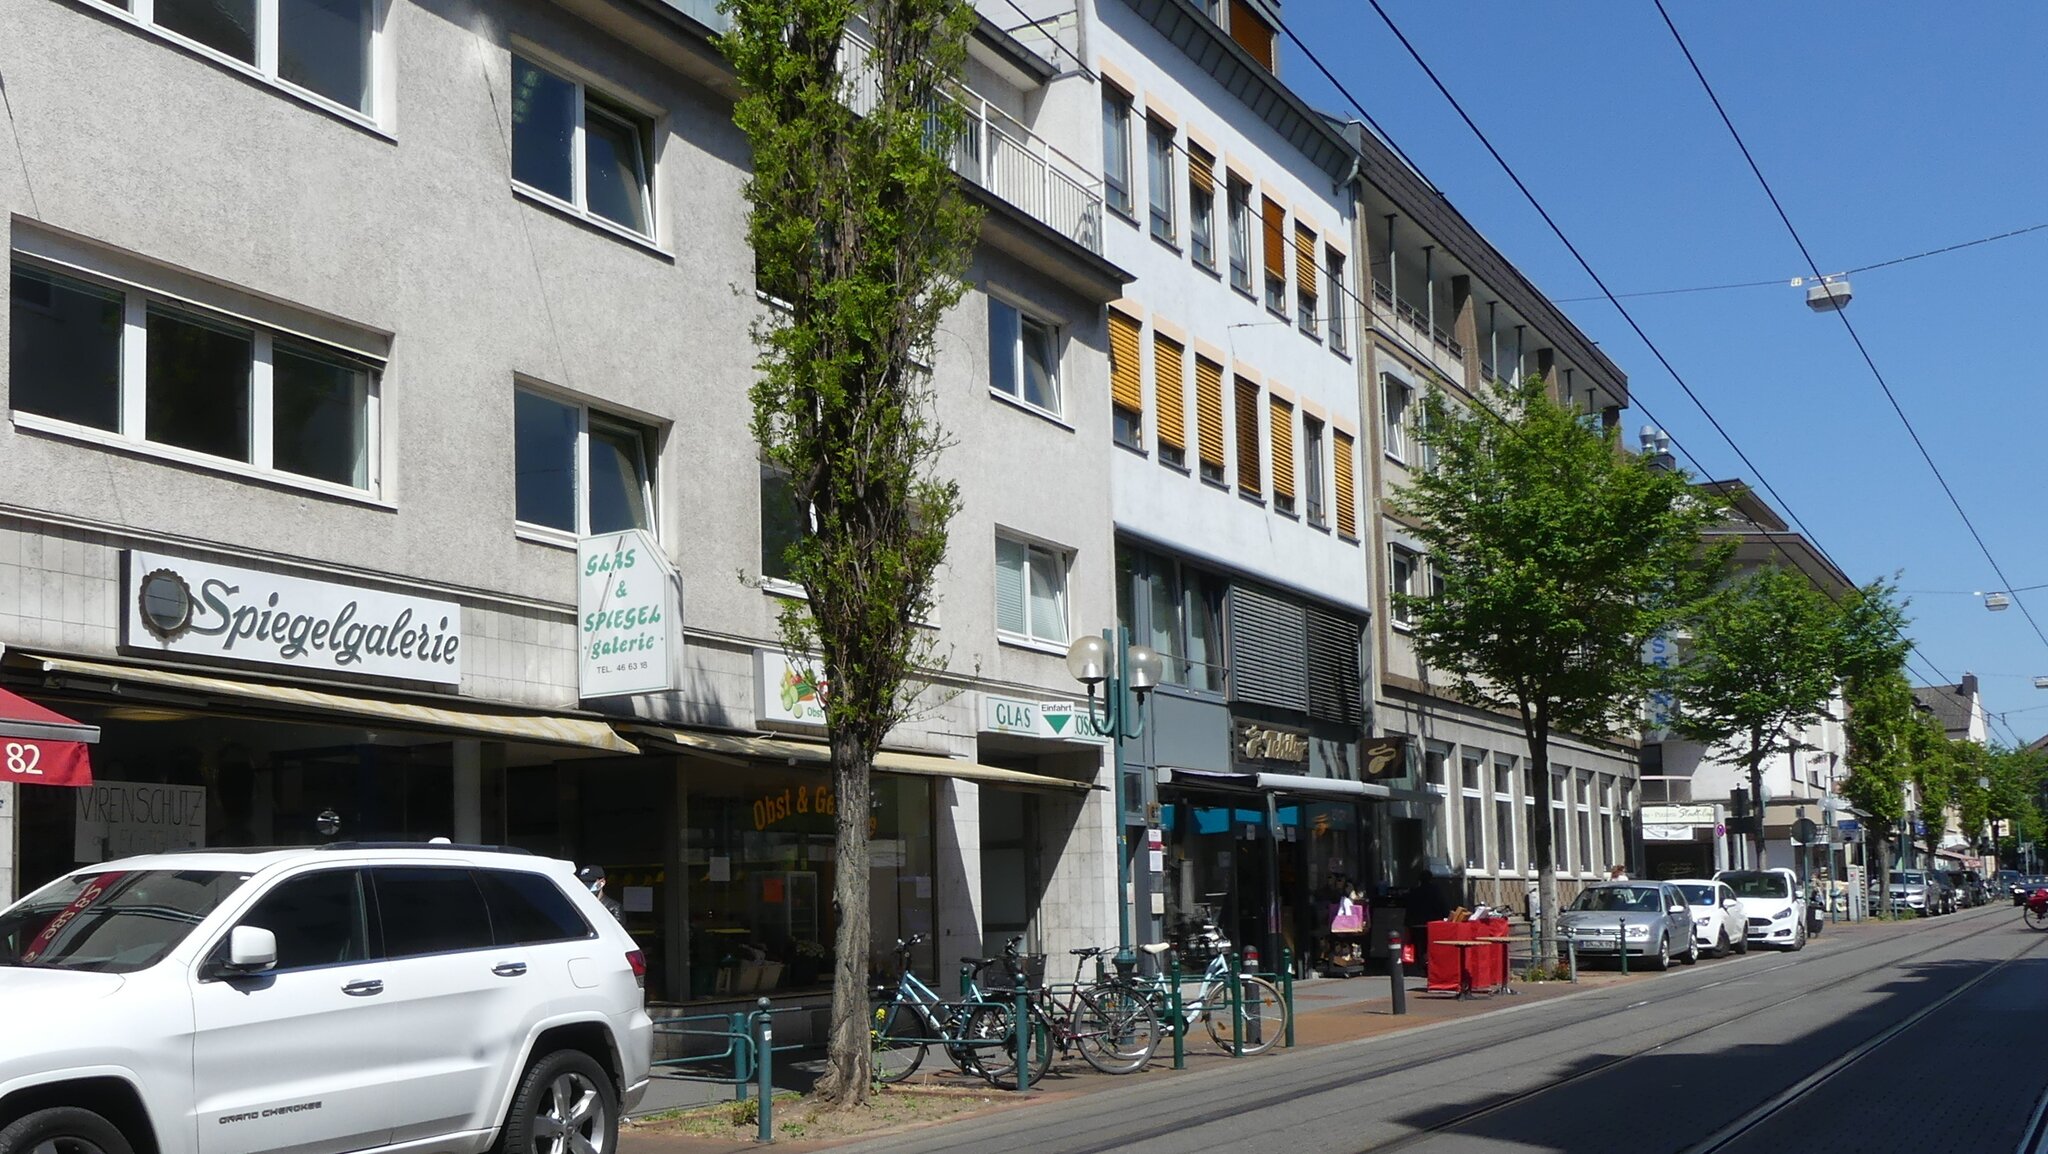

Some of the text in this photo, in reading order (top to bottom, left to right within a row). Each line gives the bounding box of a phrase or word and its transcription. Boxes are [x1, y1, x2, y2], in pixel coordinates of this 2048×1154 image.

[585, 548, 636, 577] GLAS
[615, 580, 627, 598] &
[189, 578, 458, 666] Spiegelgalerie
[583, 604, 661, 633] SPIEGEL
[591, 632, 655, 660] galerie
[597, 661, 648, 674] TEL. 46 63 18
[807, 706, 824, 718] Obst
[996, 703, 1031, 728] GLAS
[1041, 703, 1072, 712] Einfahrt
[6, 742, 43, 775] 82
[78, 787, 203, 827] VIRENSCHUTZ
[753, 788, 791, 832] Obst
[797, 785, 809, 815] &
[218, 1101, 322, 1125] GRAND CHEROKEE
